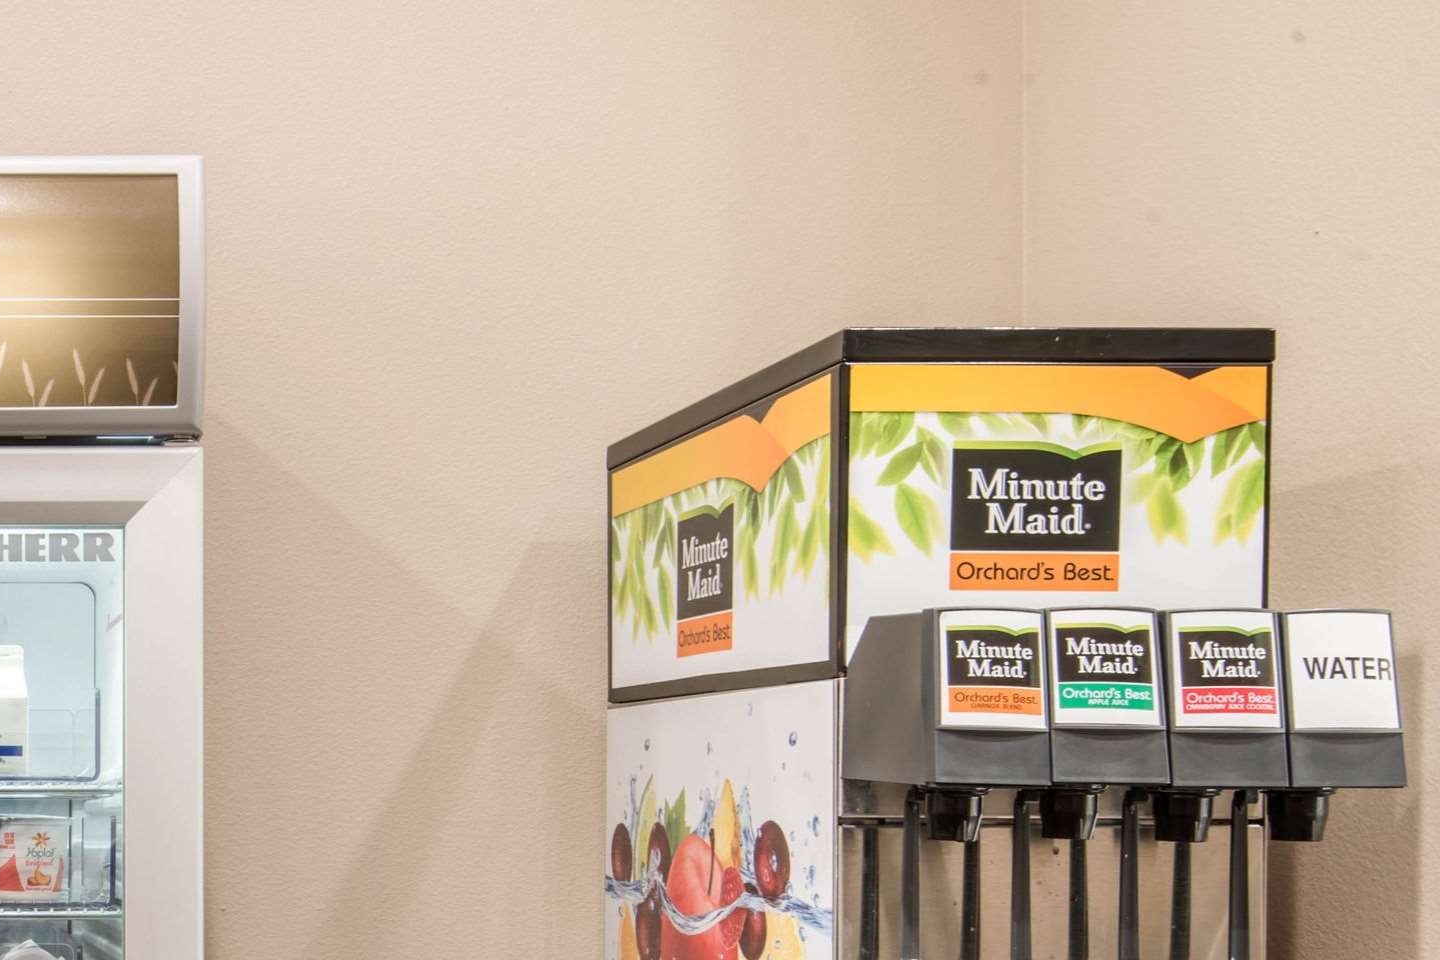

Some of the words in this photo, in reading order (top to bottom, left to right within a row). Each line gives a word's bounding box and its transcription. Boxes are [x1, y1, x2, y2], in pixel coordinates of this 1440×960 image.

[967, 468, 1106, 501] Minute
[985, 502, 1086, 534] Maid
[681, 532, 729, 570] Minute
[956, 562, 1055, 580] Orchard's
[1063, 562, 1114, 581] Best
[687, 563, 721, 601] Maid
[678, 625, 711, 648] Orchard's
[1065, 637, 1144, 656] Minute
[955, 640, 1033, 660] Minute
[1188, 641, 1267, 660] Minute
[967, 659, 1025, 679] Maid
[1078, 656, 1136, 675] Maid
[1201, 659, 1259, 679] Maid
[1303, 657, 1392, 680] WATER
[954, 691, 1009, 704] Orchard's
[1013, 693, 1038, 705] Best
[1063, 687, 1121, 699] Orchard's
[1125, 688, 1152, 700] Best
[1186, 692, 1245, 704] Orchard's
[1248, 692, 1274, 704] Best
